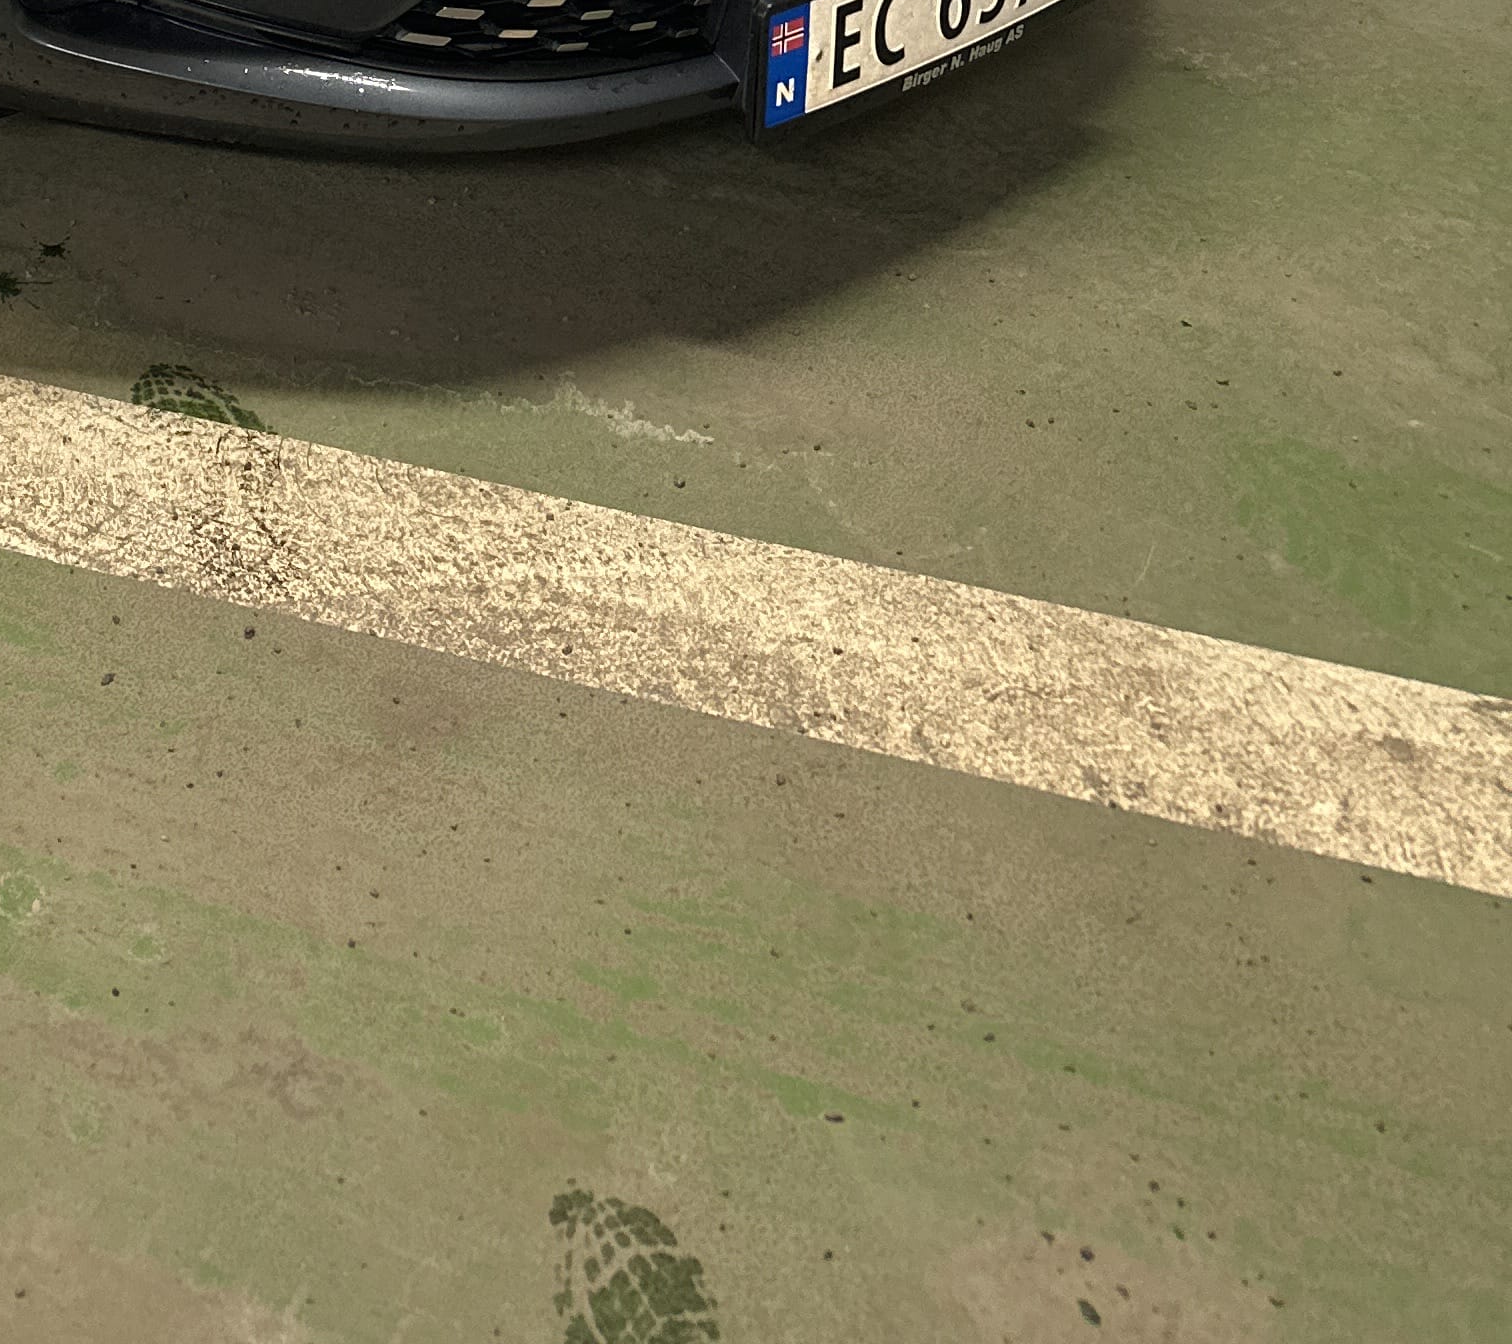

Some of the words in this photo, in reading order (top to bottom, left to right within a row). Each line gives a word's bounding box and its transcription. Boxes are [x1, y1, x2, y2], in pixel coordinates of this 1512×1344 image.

[902, 62, 947, 92] Birger
[950, 53, 965, 70] N.
[969, 37, 1003, 62] Haug
[1005, 24, 1024, 44] AS
[775, 78, 795, 107] N
